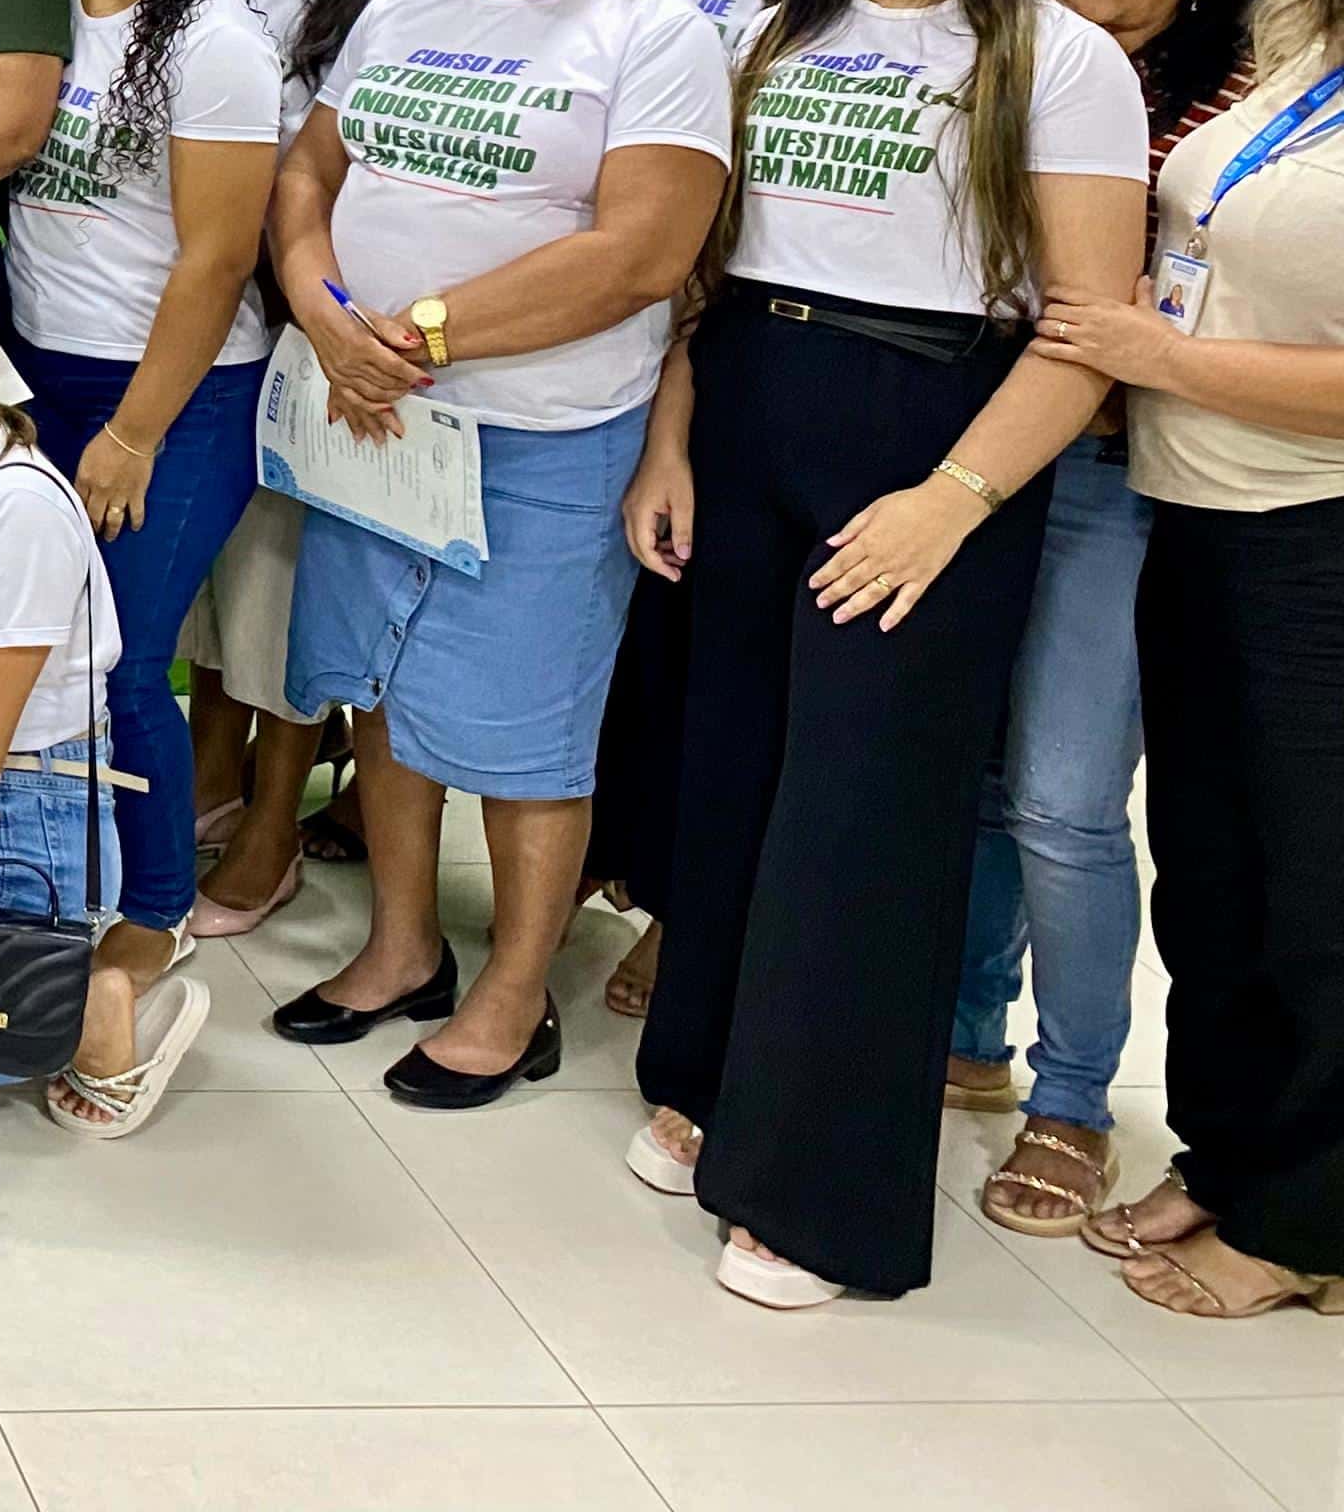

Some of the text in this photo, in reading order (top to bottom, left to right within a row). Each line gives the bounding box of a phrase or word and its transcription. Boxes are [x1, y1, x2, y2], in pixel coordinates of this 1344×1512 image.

[356, 64, 518, 104] OSTUREIRO
[406, 48, 534, 76] CURSO DE
[68, 85, 102, 111] DE
[349, 87, 522, 139] INDUSTRIAL
[341, 116, 537, 173] DO VESTUÁRIO
[362, 144, 499, 190] EM MALHA
[764, 124, 937, 175] VESTUÁRIO
[749, 154, 889, 201] EM MALHA
